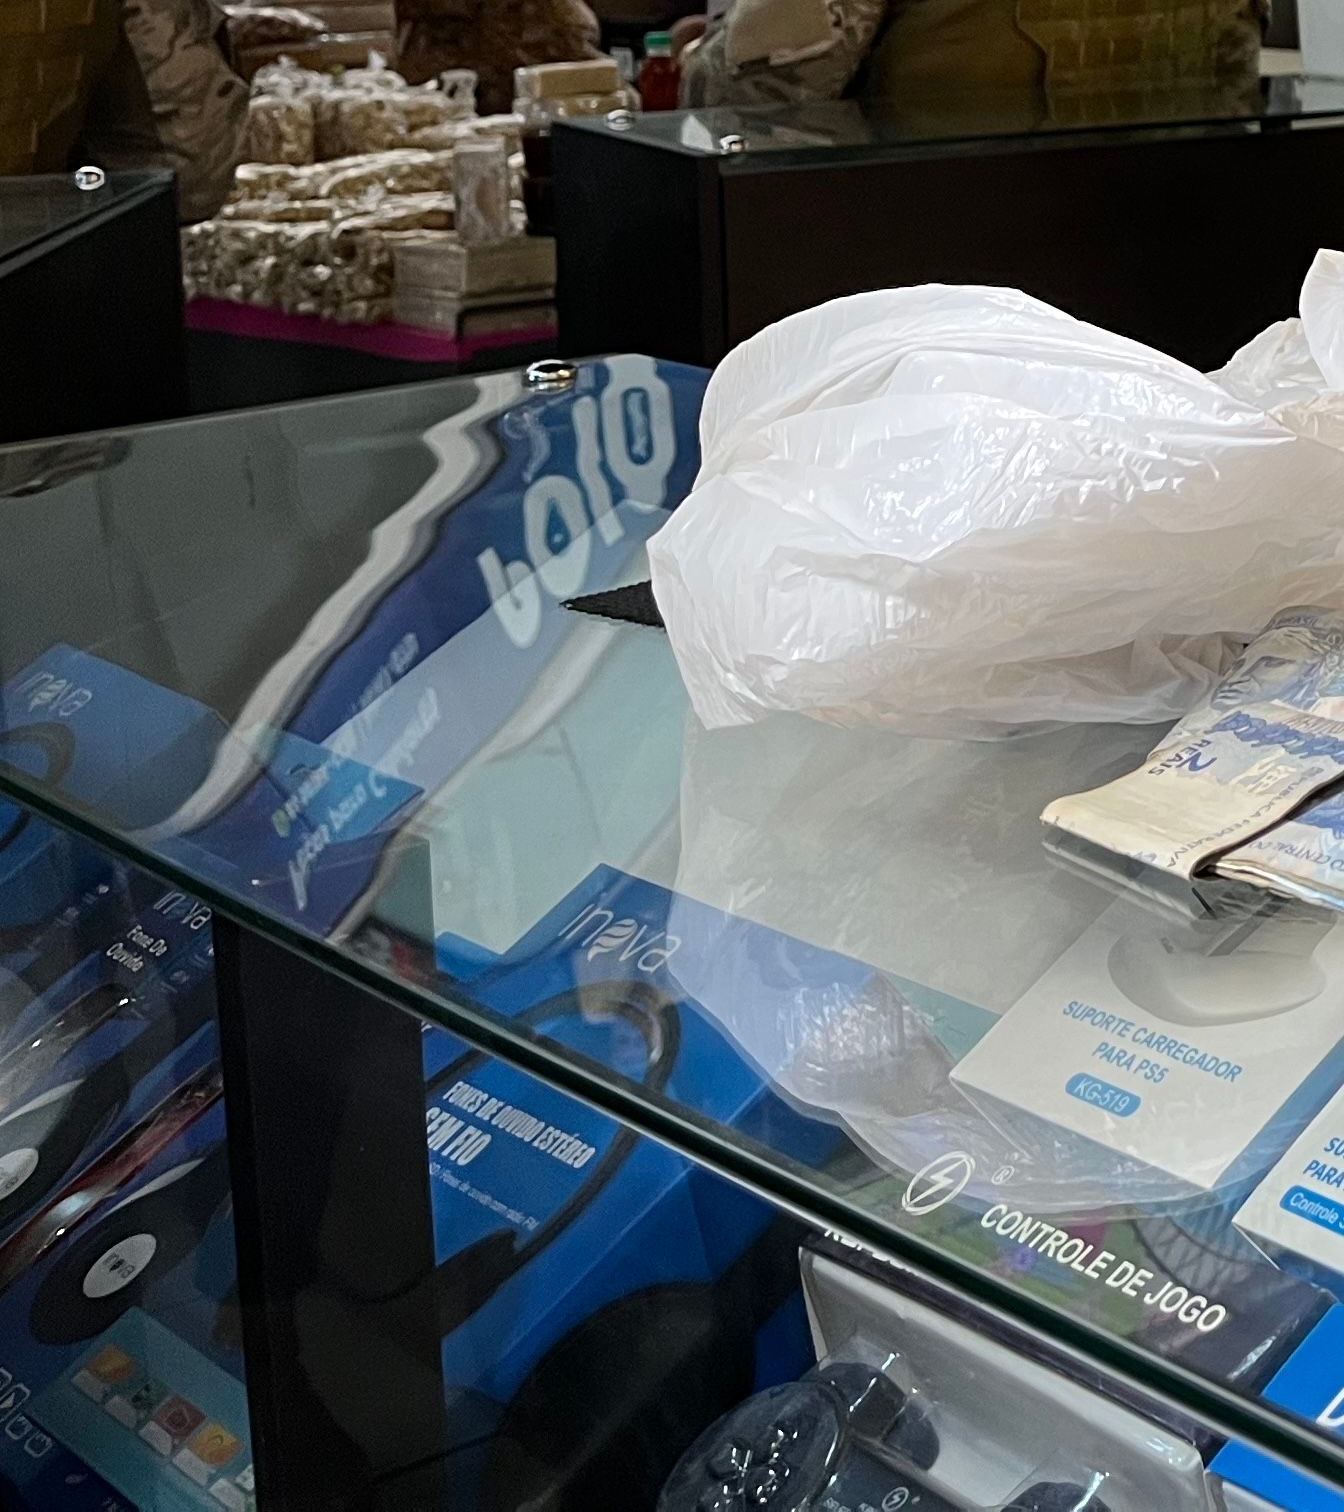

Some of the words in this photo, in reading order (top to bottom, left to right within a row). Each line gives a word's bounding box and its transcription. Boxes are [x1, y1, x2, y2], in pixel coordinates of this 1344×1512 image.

[1147, 738, 1212, 776] REAIS
[1062, 999, 1136, 1039] SUPORTE
[1131, 1026, 1244, 1083] CARREGADOR
[1091, 1041, 1135, 1072] PARA
[1133, 1057, 1170, 1084] PS5
[1073, 1077, 1131, 1114] KG-519
[440, 1125, 492, 1167] FIO
[442, 1080, 489, 1114] FONES
[531, 1125, 597, 1170] ESTÉREO
[1289, 1191, 1339, 1225] Controle
[980, 1202, 1116, 1280] CONTROLE
[1104, 1259, 1155, 1299] DE
[1143, 1280, 1228, 1333] JOGO
